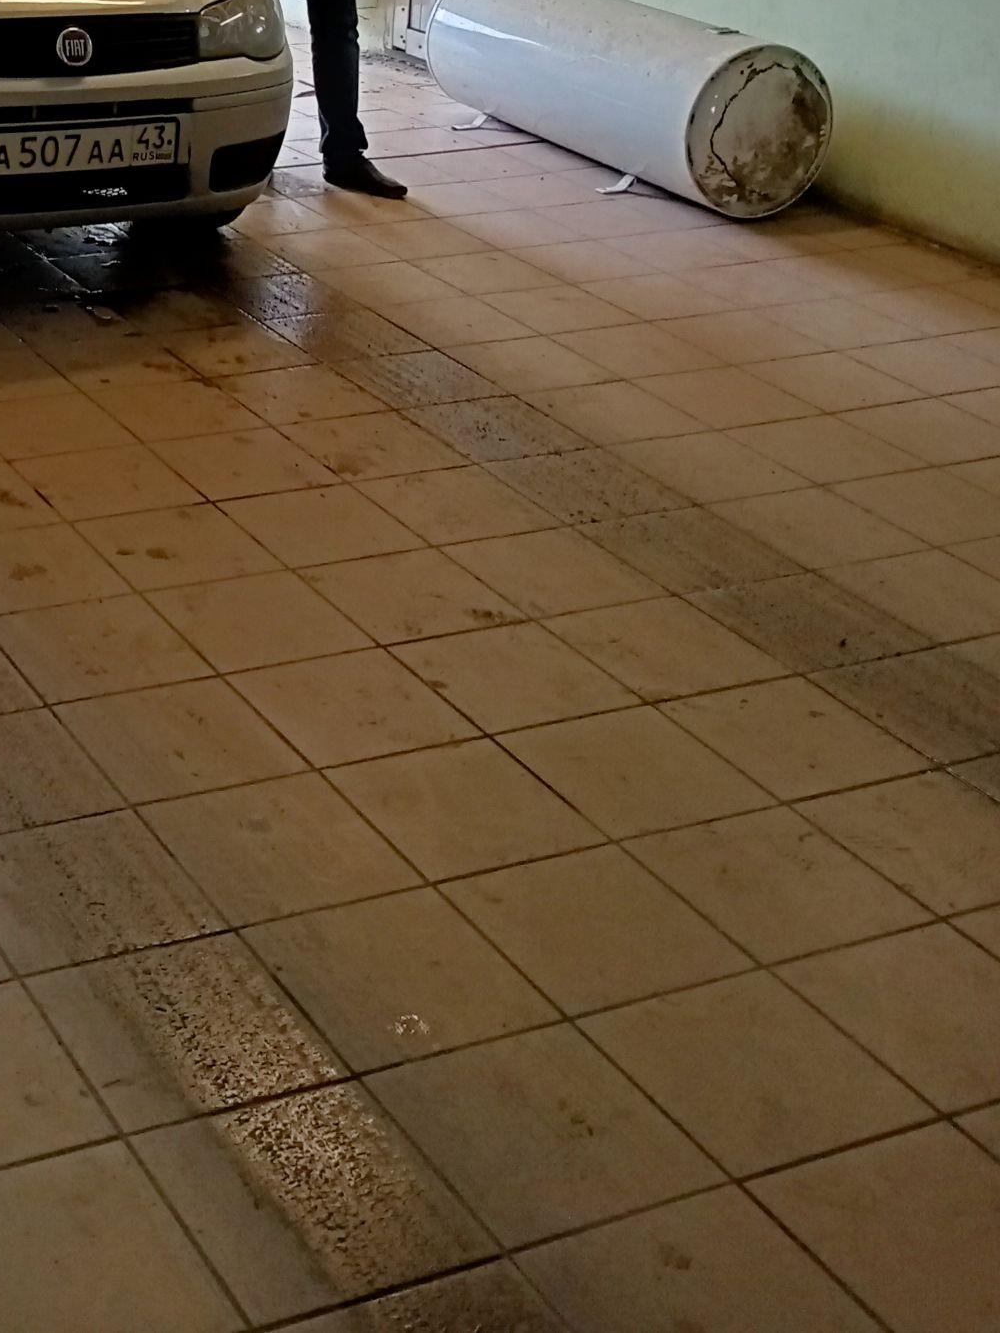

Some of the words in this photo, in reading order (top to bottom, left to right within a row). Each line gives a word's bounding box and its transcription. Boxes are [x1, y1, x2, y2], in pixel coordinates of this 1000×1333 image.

[65, 39, 85, 56] FIAT
[137, 126, 165, 149] 43
[133, 151, 154, 161] RUS
